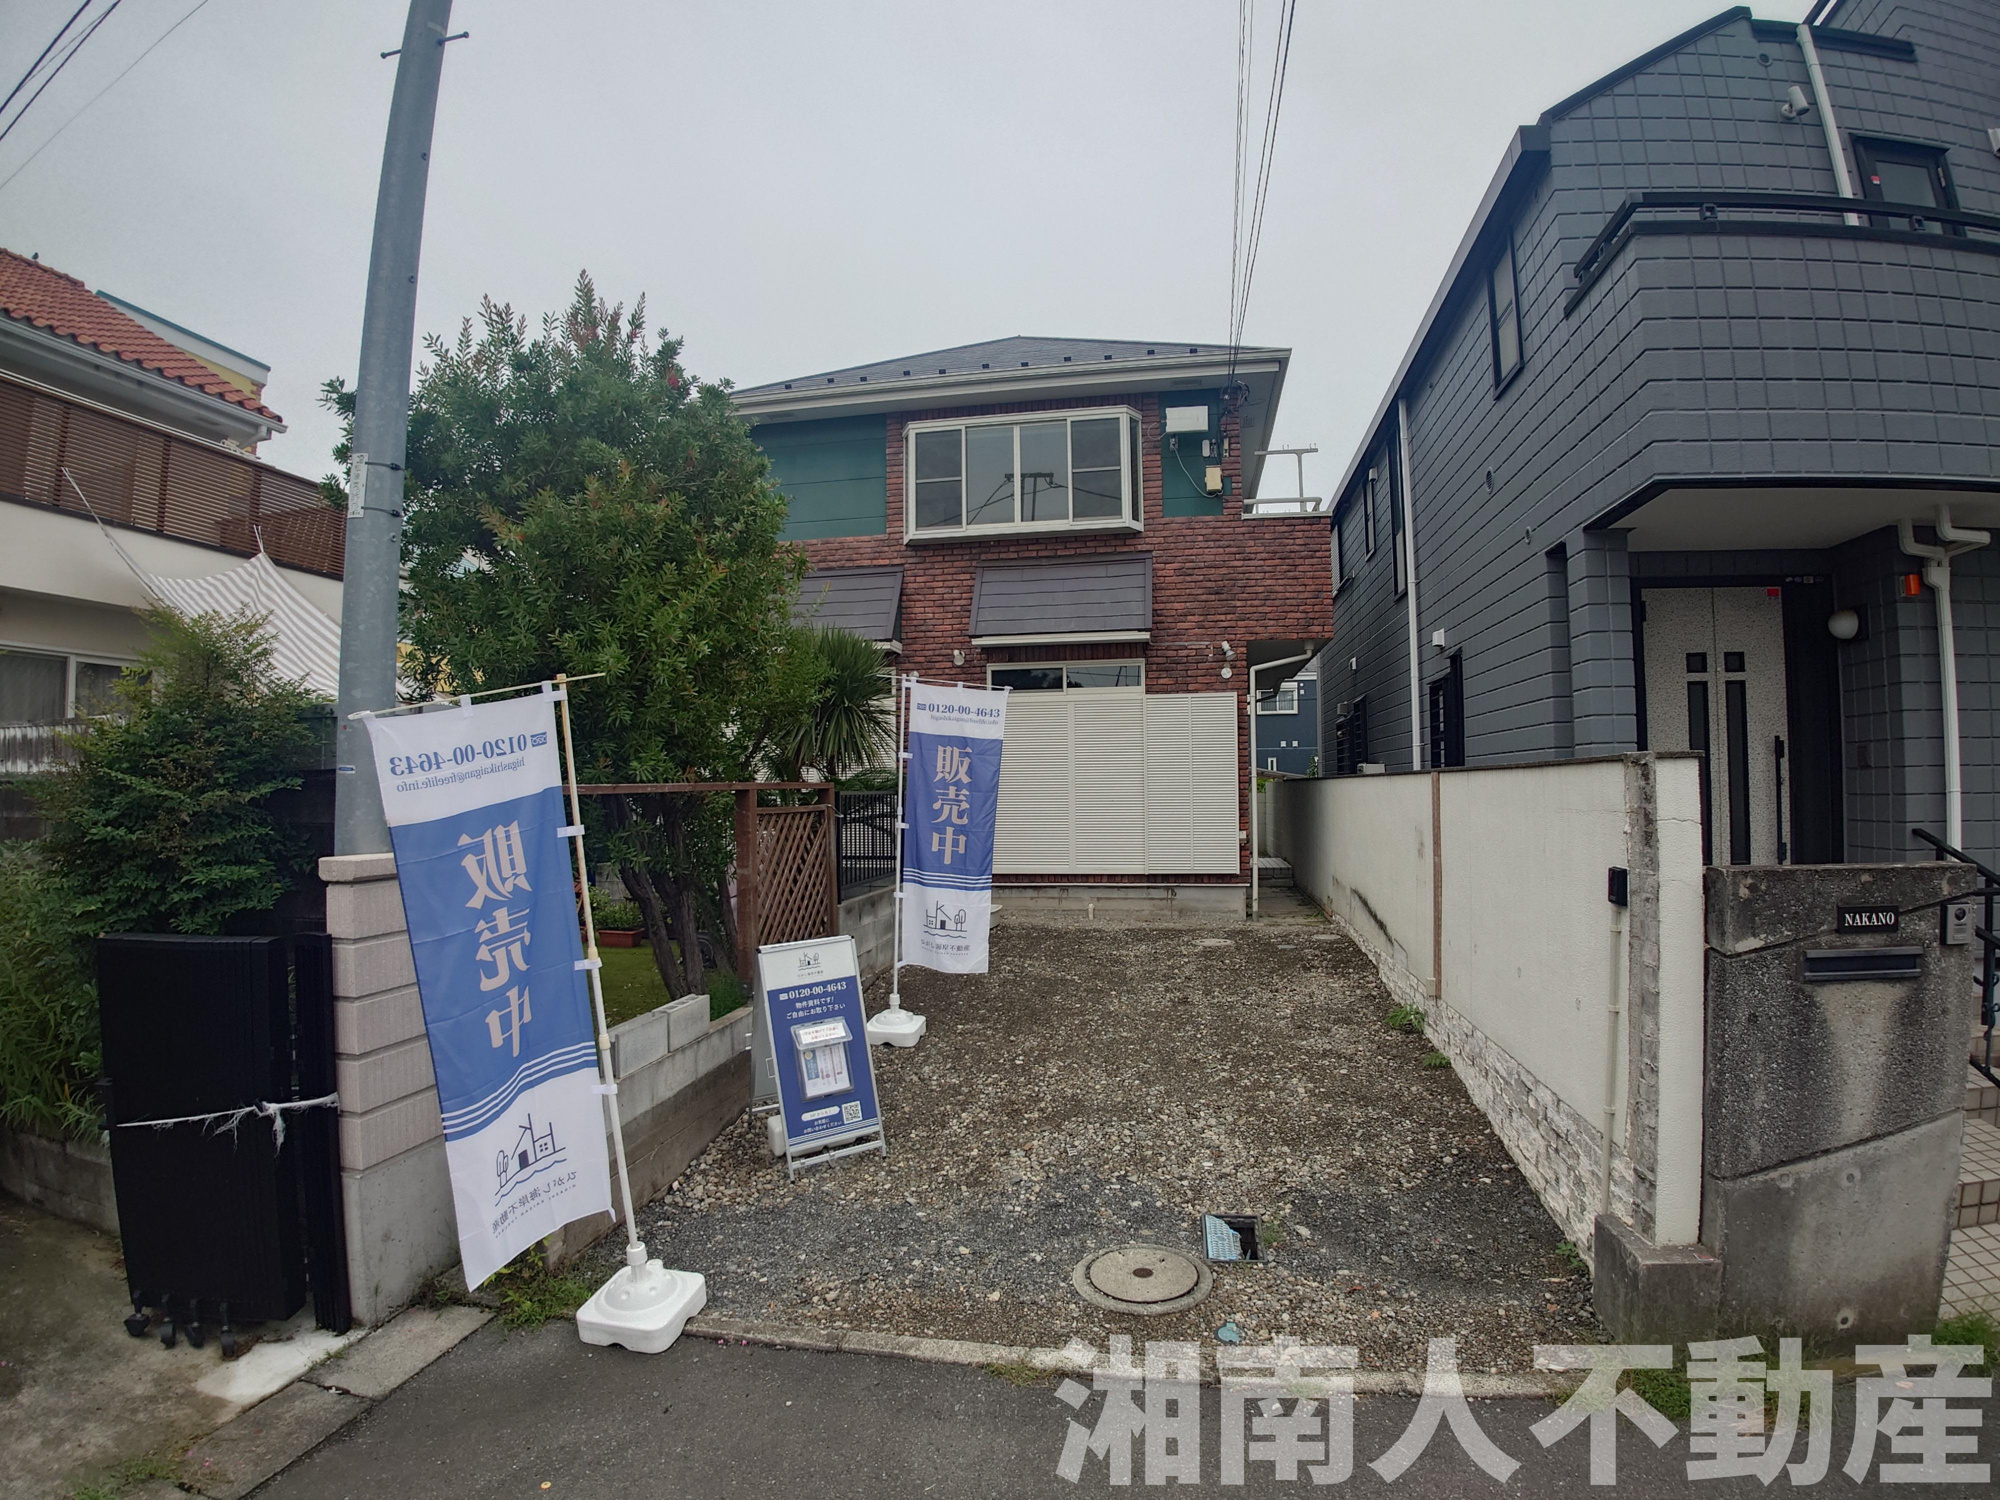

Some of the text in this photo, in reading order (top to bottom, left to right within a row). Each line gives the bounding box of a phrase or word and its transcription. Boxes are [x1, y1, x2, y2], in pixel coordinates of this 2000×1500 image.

[928, 702, 1001, 718] 0120-00-4643
[931, 744, 973, 866] 販売中
[1844, 911, 1896, 927] NAKANO
[788, 981, 847, 999] 0120-00-4643
[786, 1003, 846, 1020] ご自由にお取り下さい
